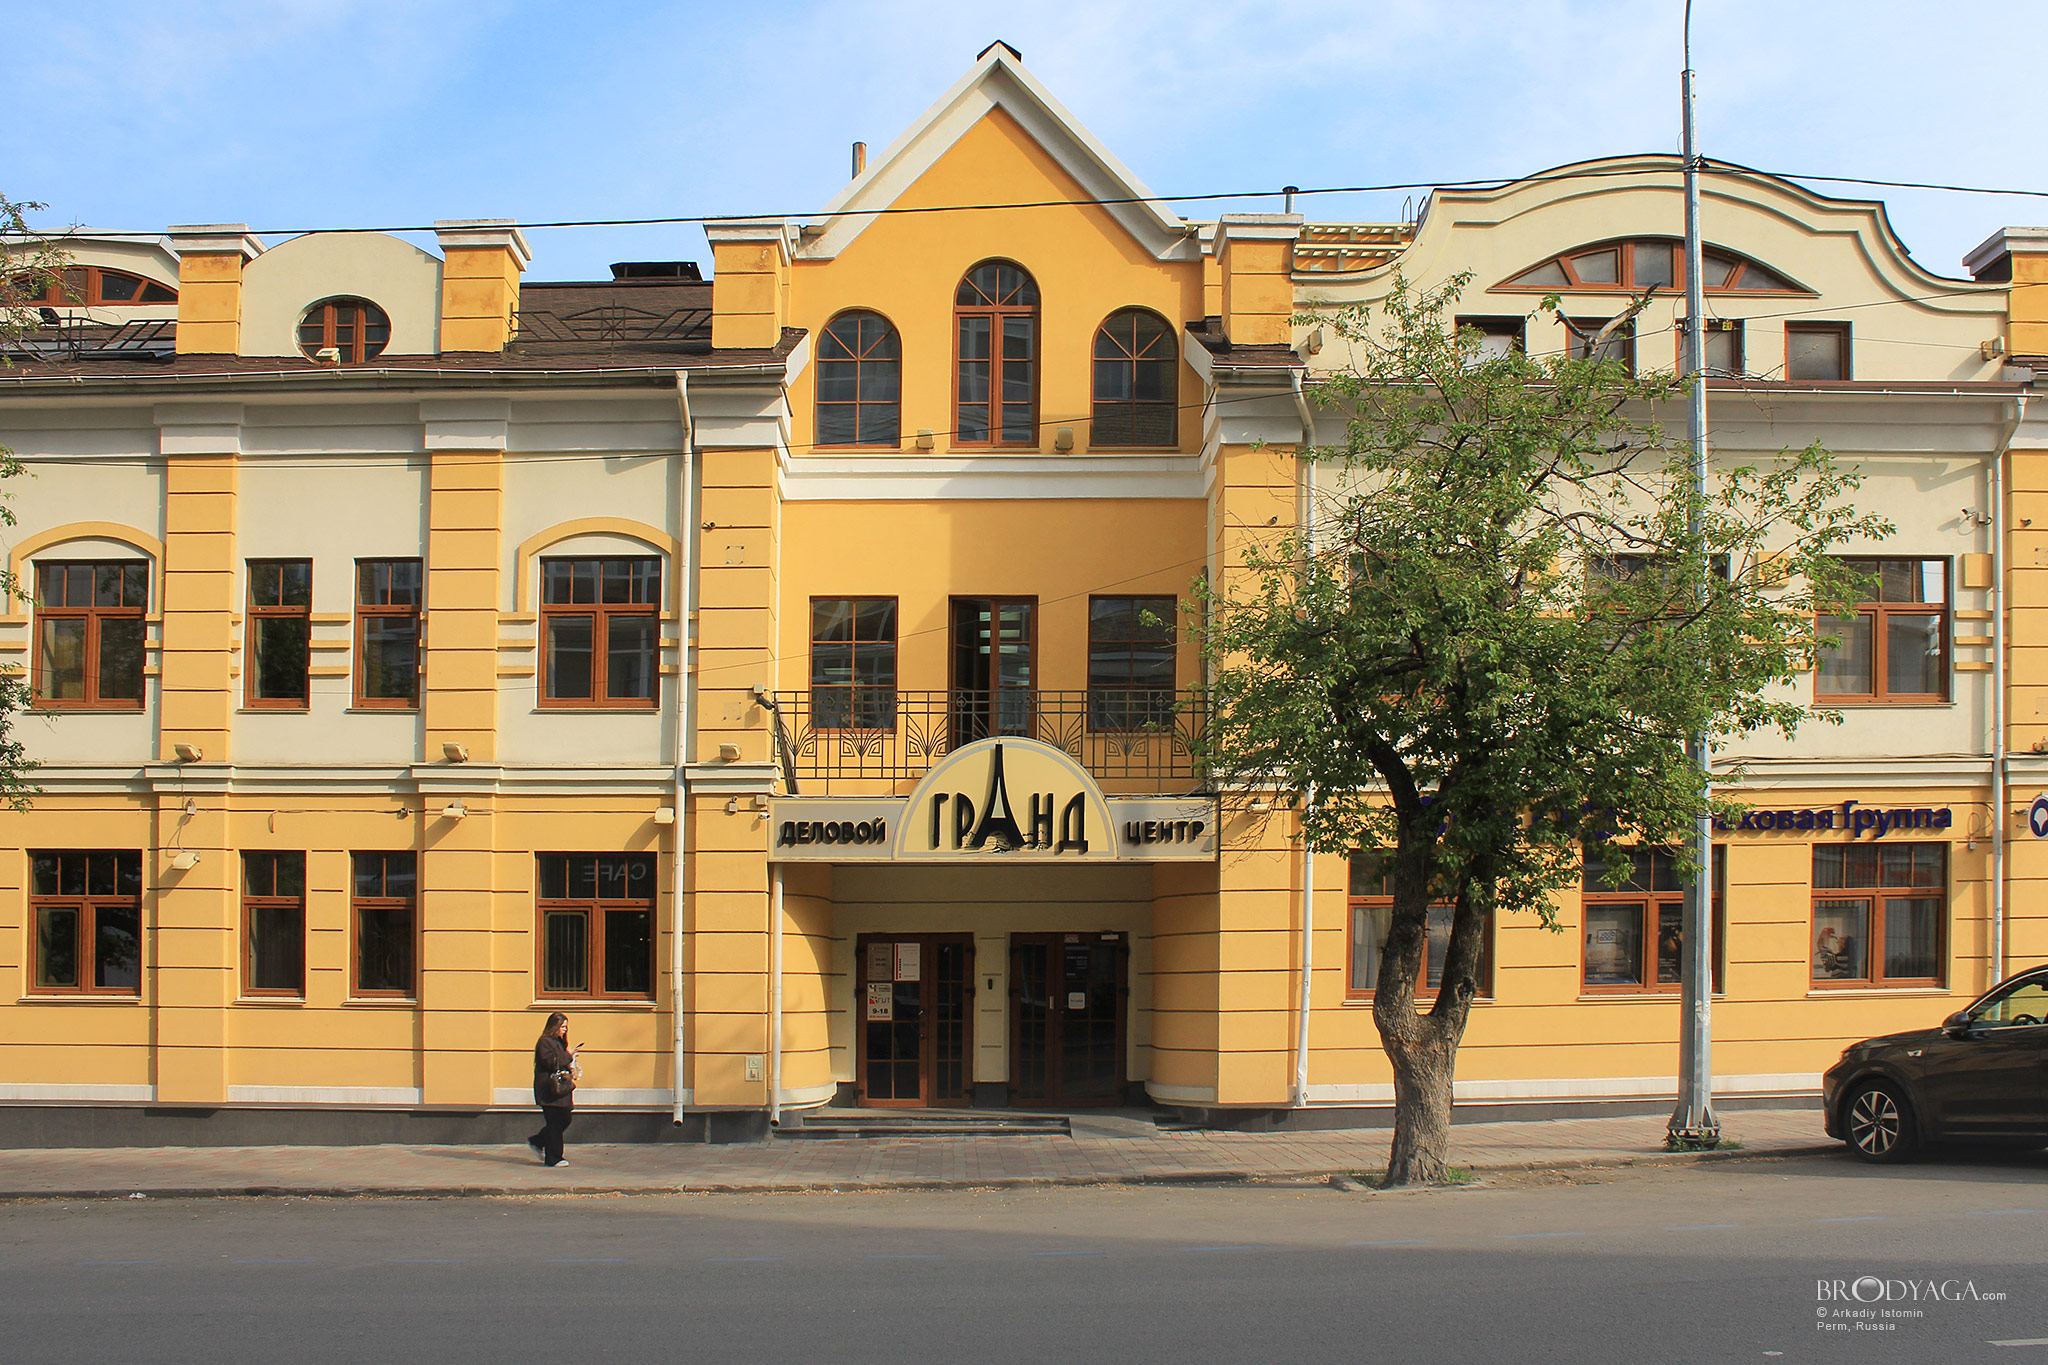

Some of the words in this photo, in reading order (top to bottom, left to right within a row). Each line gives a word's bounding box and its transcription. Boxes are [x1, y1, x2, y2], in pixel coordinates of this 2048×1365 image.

[781, 816, 886, 846] ДЕЛОВОЙ
[930, 742, 1089, 855] ГРАНД
[1125, 820, 1206, 845] ЦЕНТР
[1712, 808, 1834, 831] аховая
[1843, 800, 1952, 838] Группа
